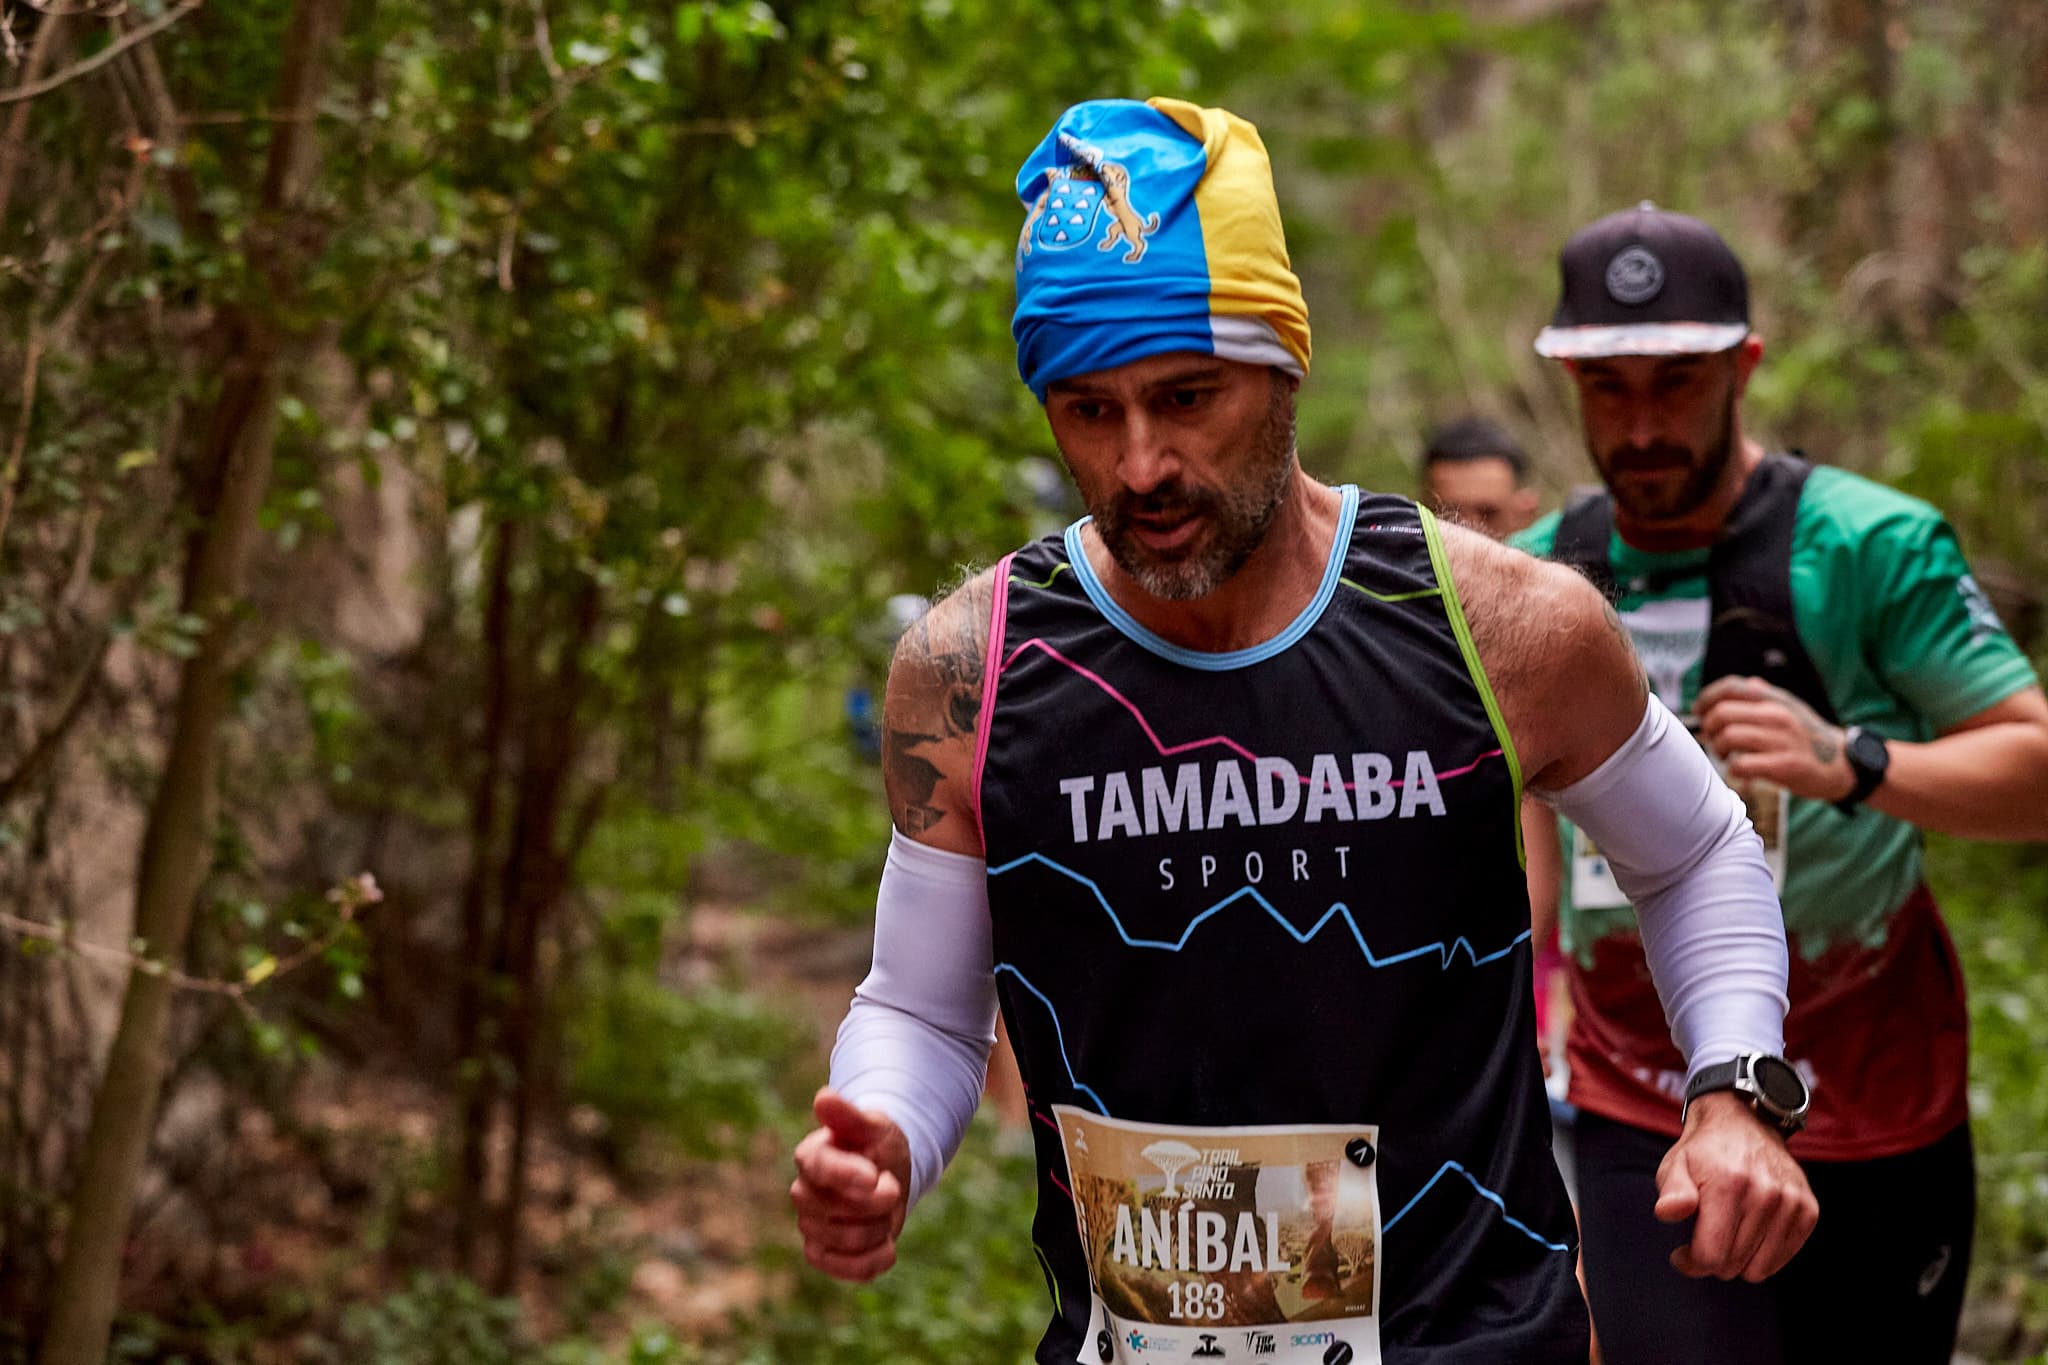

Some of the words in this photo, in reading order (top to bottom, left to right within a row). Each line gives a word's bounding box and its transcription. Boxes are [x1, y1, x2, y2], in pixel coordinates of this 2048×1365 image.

[1059, 750, 1447, 843] TAMADABA
[1159, 846, 1351, 890] SPORT
[1192, 1166, 1229, 1183] PINO
[1201, 1149, 1242, 1166] TRAIL
[1182, 1182, 1235, 1200] SANTO
[1112, 1200, 1291, 1273] ANÍBAL
[1167, 1281, 1225, 1320] 183
